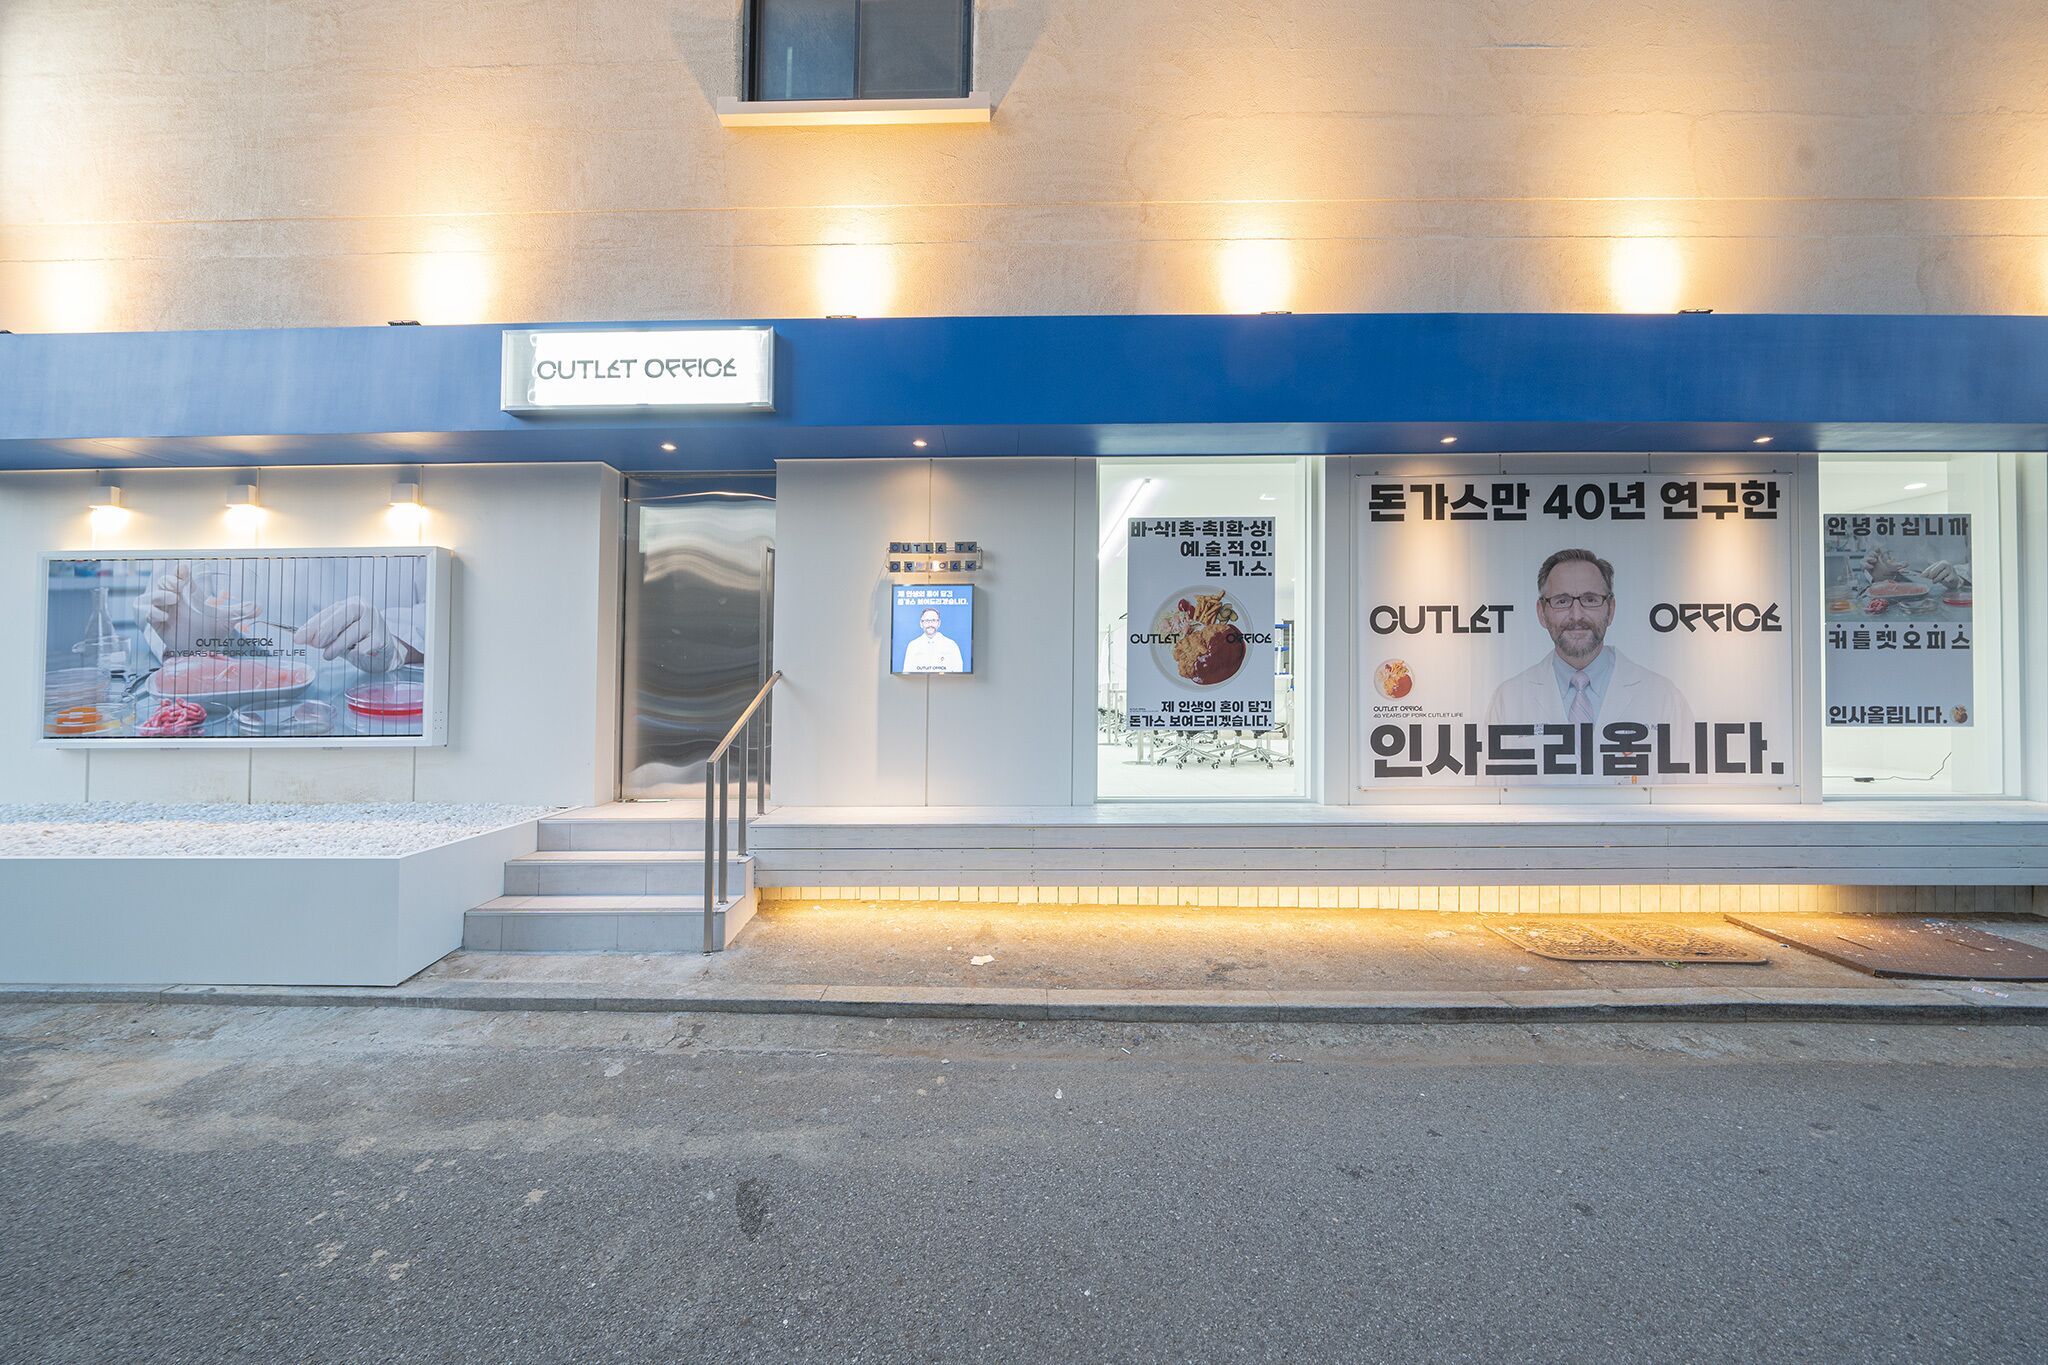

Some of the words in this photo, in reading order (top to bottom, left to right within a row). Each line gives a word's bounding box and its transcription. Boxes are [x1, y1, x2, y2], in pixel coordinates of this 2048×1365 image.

[537, 359, 638, 380] CUTLET
[644, 357, 737, 379] OFFICE
[1369, 482, 1530, 522] 돈가스만
[1543, 481, 1646, 520] 40년
[1661, 480, 1781, 520] 연구한
[1369, 603, 1514, 635] CUTLET
[1649, 602, 1783, 633] OFFICE
[236, 637, 274, 647] OFFICE
[1130, 633, 1180, 644] CUTLET
[1226, 633, 1272, 644] OFFICE
[1161, 700, 1175, 713] 제
[1178, 700, 1216, 713] 인생의
[1220, 700, 1244, 713] 혼이
[1248, 700, 1272, 713] 담긴
[1829, 705, 1948, 725] 인사올립니다.
[1129, 715, 1166, 727] 돈가스
[1170, 715, 1272, 727] 보여드리겠습니다.
[1369, 721, 1785, 779] 인사드리옵니다.
